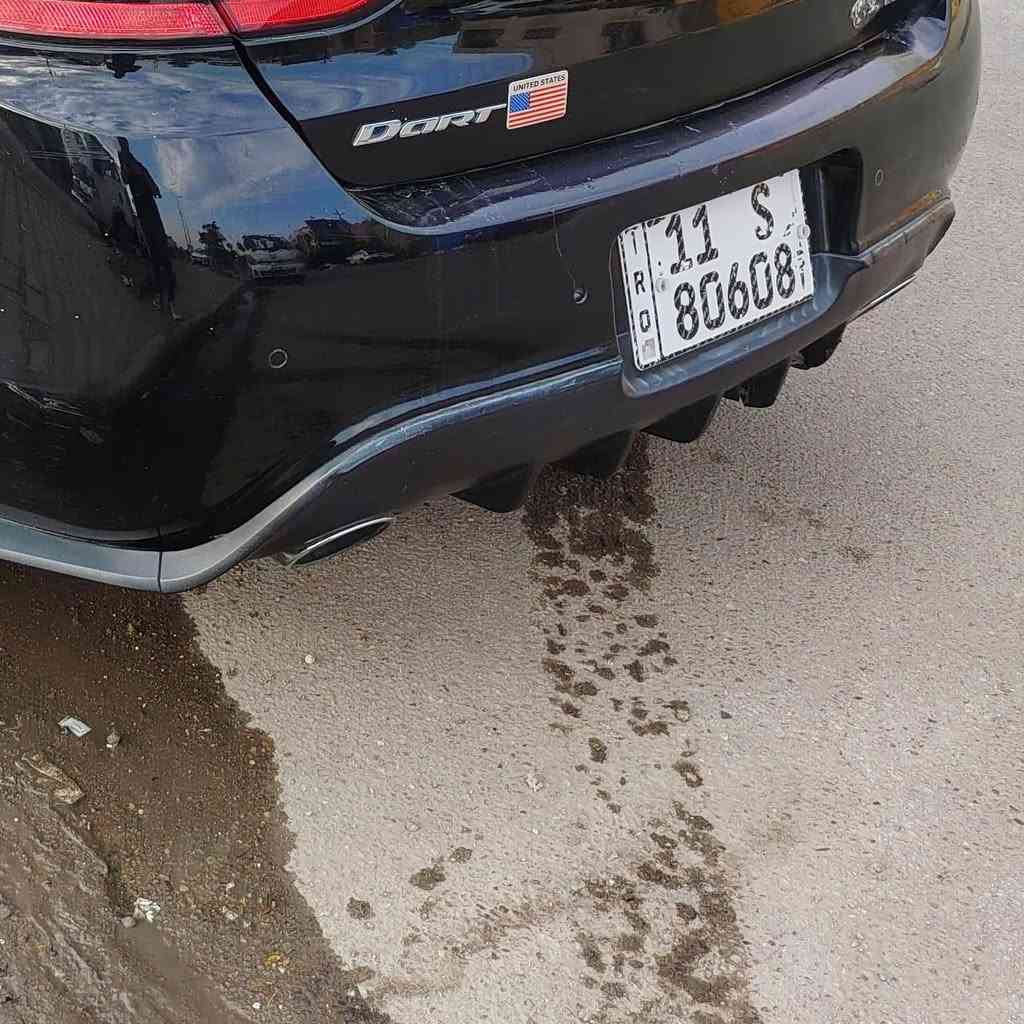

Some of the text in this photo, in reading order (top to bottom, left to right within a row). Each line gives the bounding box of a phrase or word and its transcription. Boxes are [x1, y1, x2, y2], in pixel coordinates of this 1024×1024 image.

[513, 73, 566, 91] UNITED STATES
[664, 204, 720, 275] 11
[751, 182, 775, 241] S
[673, 242, 796, 341] 80608
